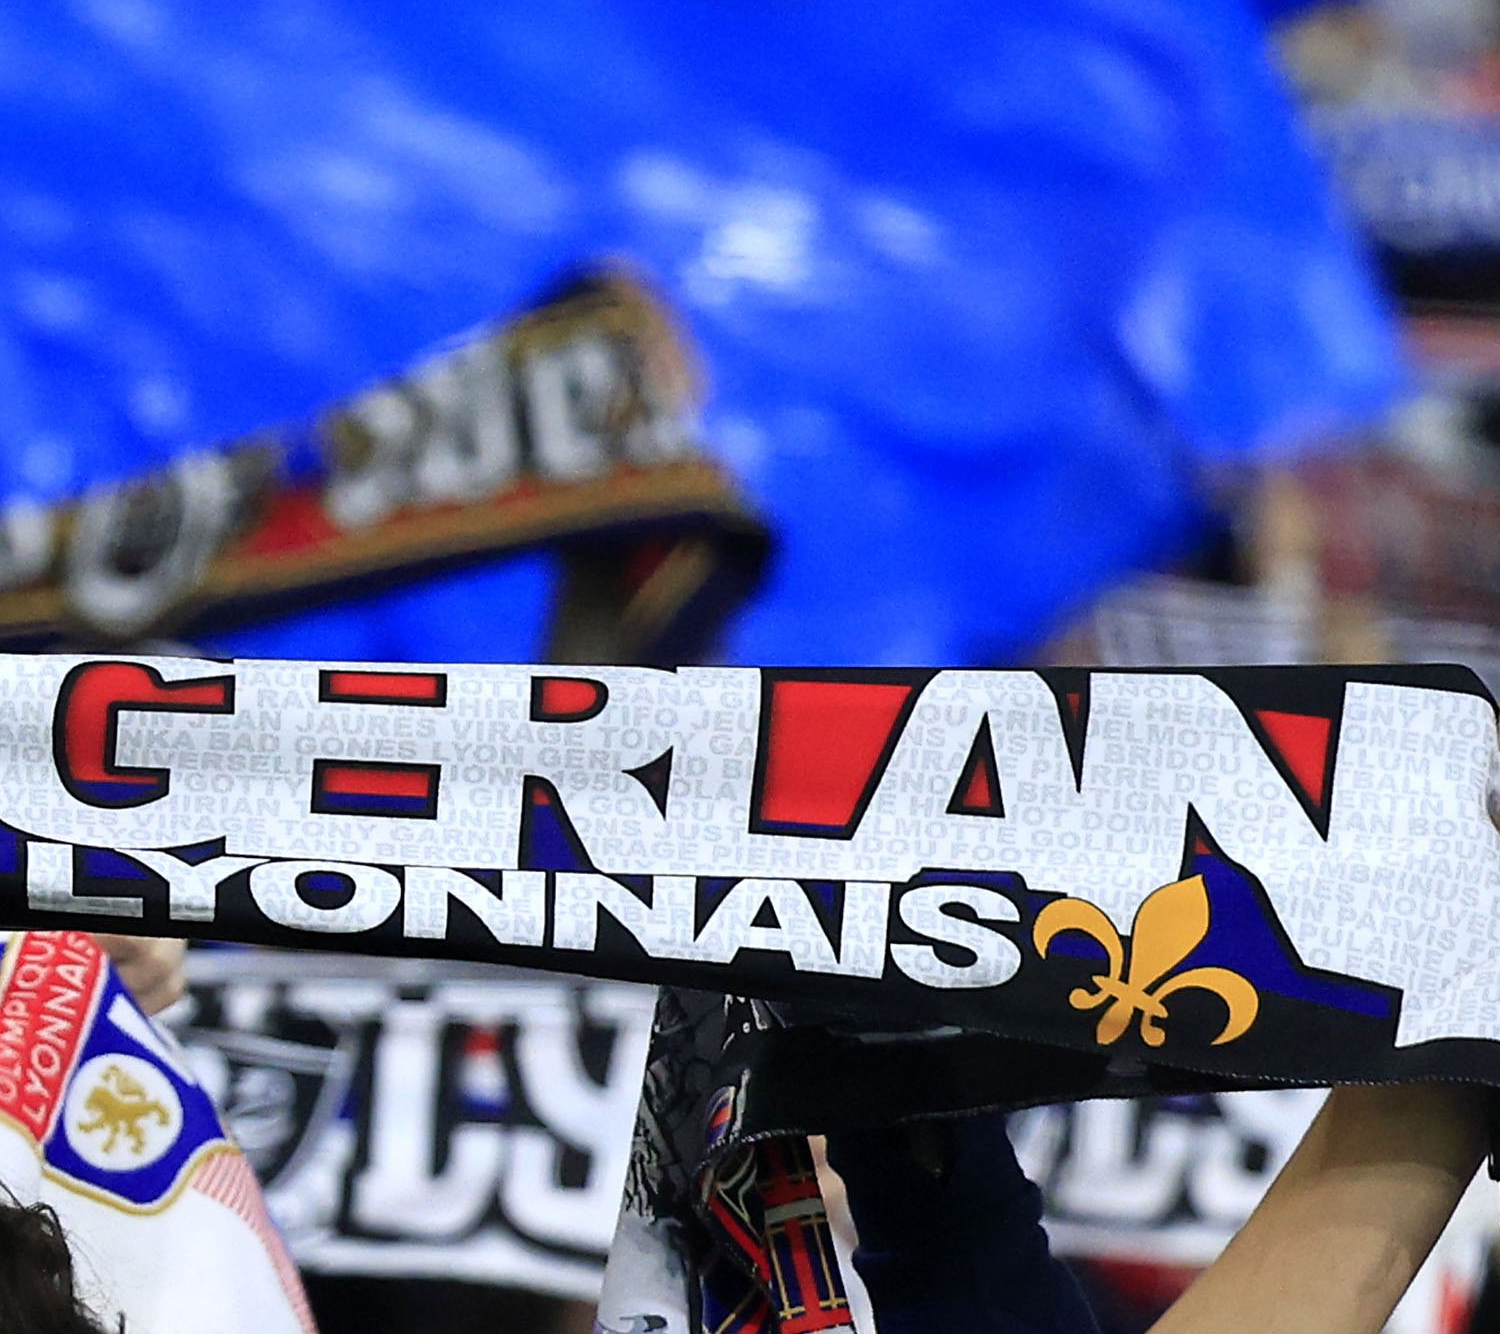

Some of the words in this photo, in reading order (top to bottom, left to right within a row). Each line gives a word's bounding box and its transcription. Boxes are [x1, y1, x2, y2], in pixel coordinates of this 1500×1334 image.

[295, 712, 437, 739] JAURES
[450, 719, 584, 746] VIRAGE
[294, 734, 418, 760] GONES
[431, 739, 525, 765] LYON
[1174, 773, 1220, 796] DE
[278, 818, 378, 839] TONY
[711, 844, 840, 872] PIERRE
[27, 841, 1021, 989] LYONNAIS
